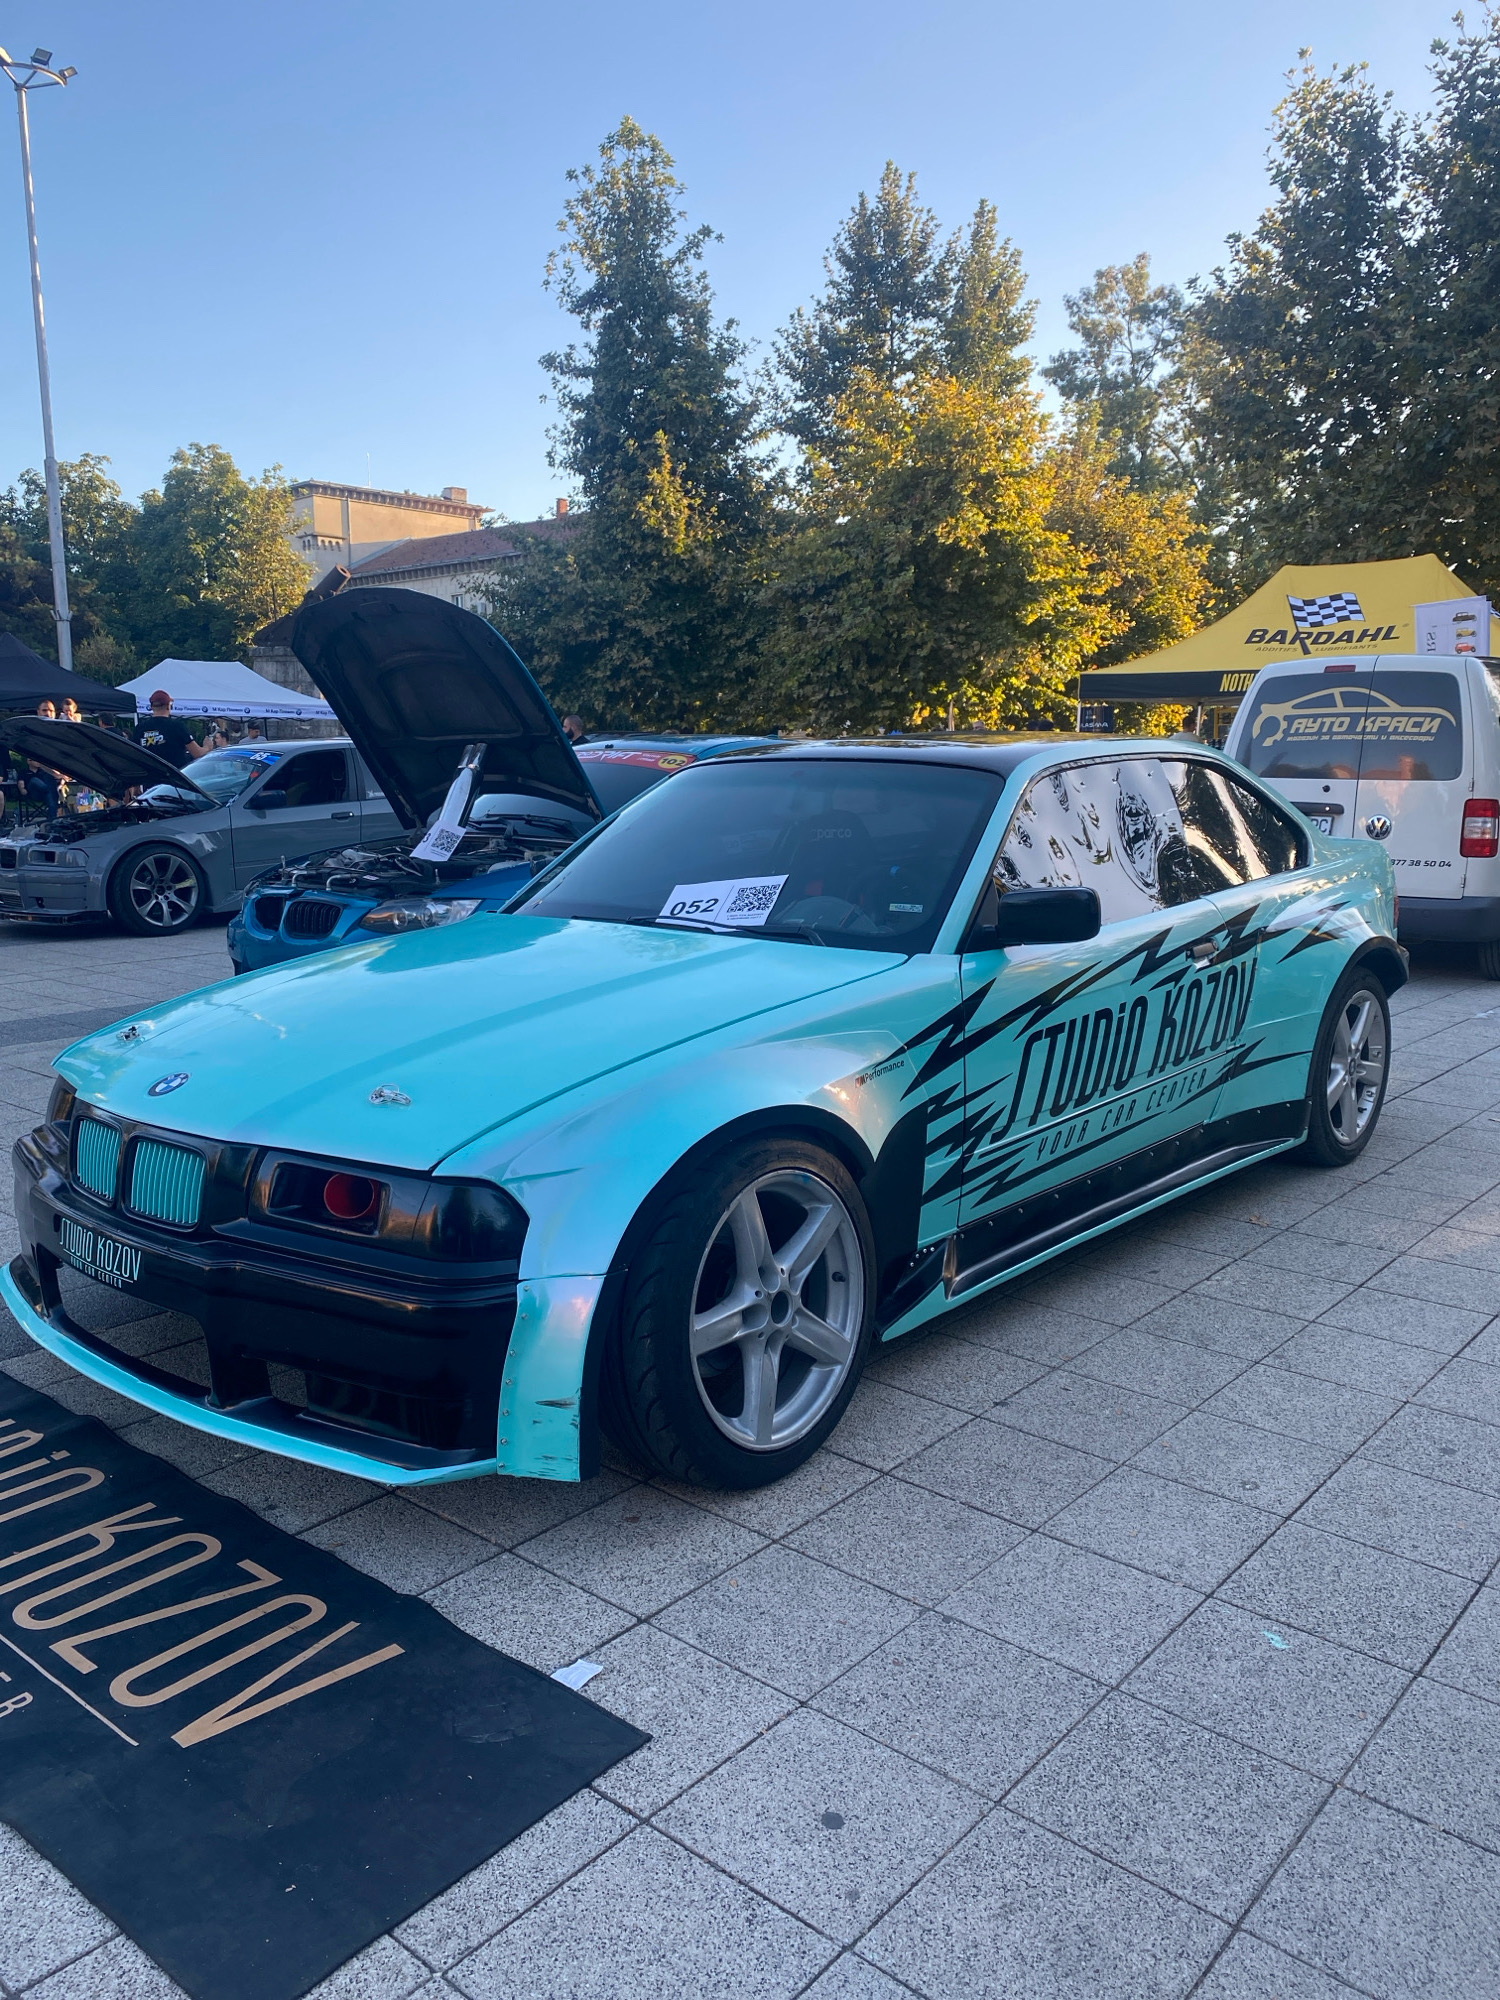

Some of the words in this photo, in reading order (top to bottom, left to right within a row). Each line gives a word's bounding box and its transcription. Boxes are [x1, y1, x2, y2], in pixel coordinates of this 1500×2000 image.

[1244, 625, 1400, 655] BARDAHL
[1315, 644, 1379, 653] LUBRIFIANTS
[1289, 716, 1352, 734] АУТО
[1356, 716, 1443, 734] КРАСИ
[661, 757, 686, 767] 102
[1408, 859, 1421, 867] 38
[1423, 859, 1437, 867] 50
[1438, 859, 1452, 868] 04
[669, 898, 719, 917] 052
[1147, 957, 1258, 1077] KOZOV
[1037, 1119, 1090, 1162] YOUR
[1101, 1099, 1137, 1132] CAR
[1145, 1068, 1207, 1113] CENTER
[97, 1235, 141, 1281] KOZOV
[0, 1501, 406, 1748] KOZOV
